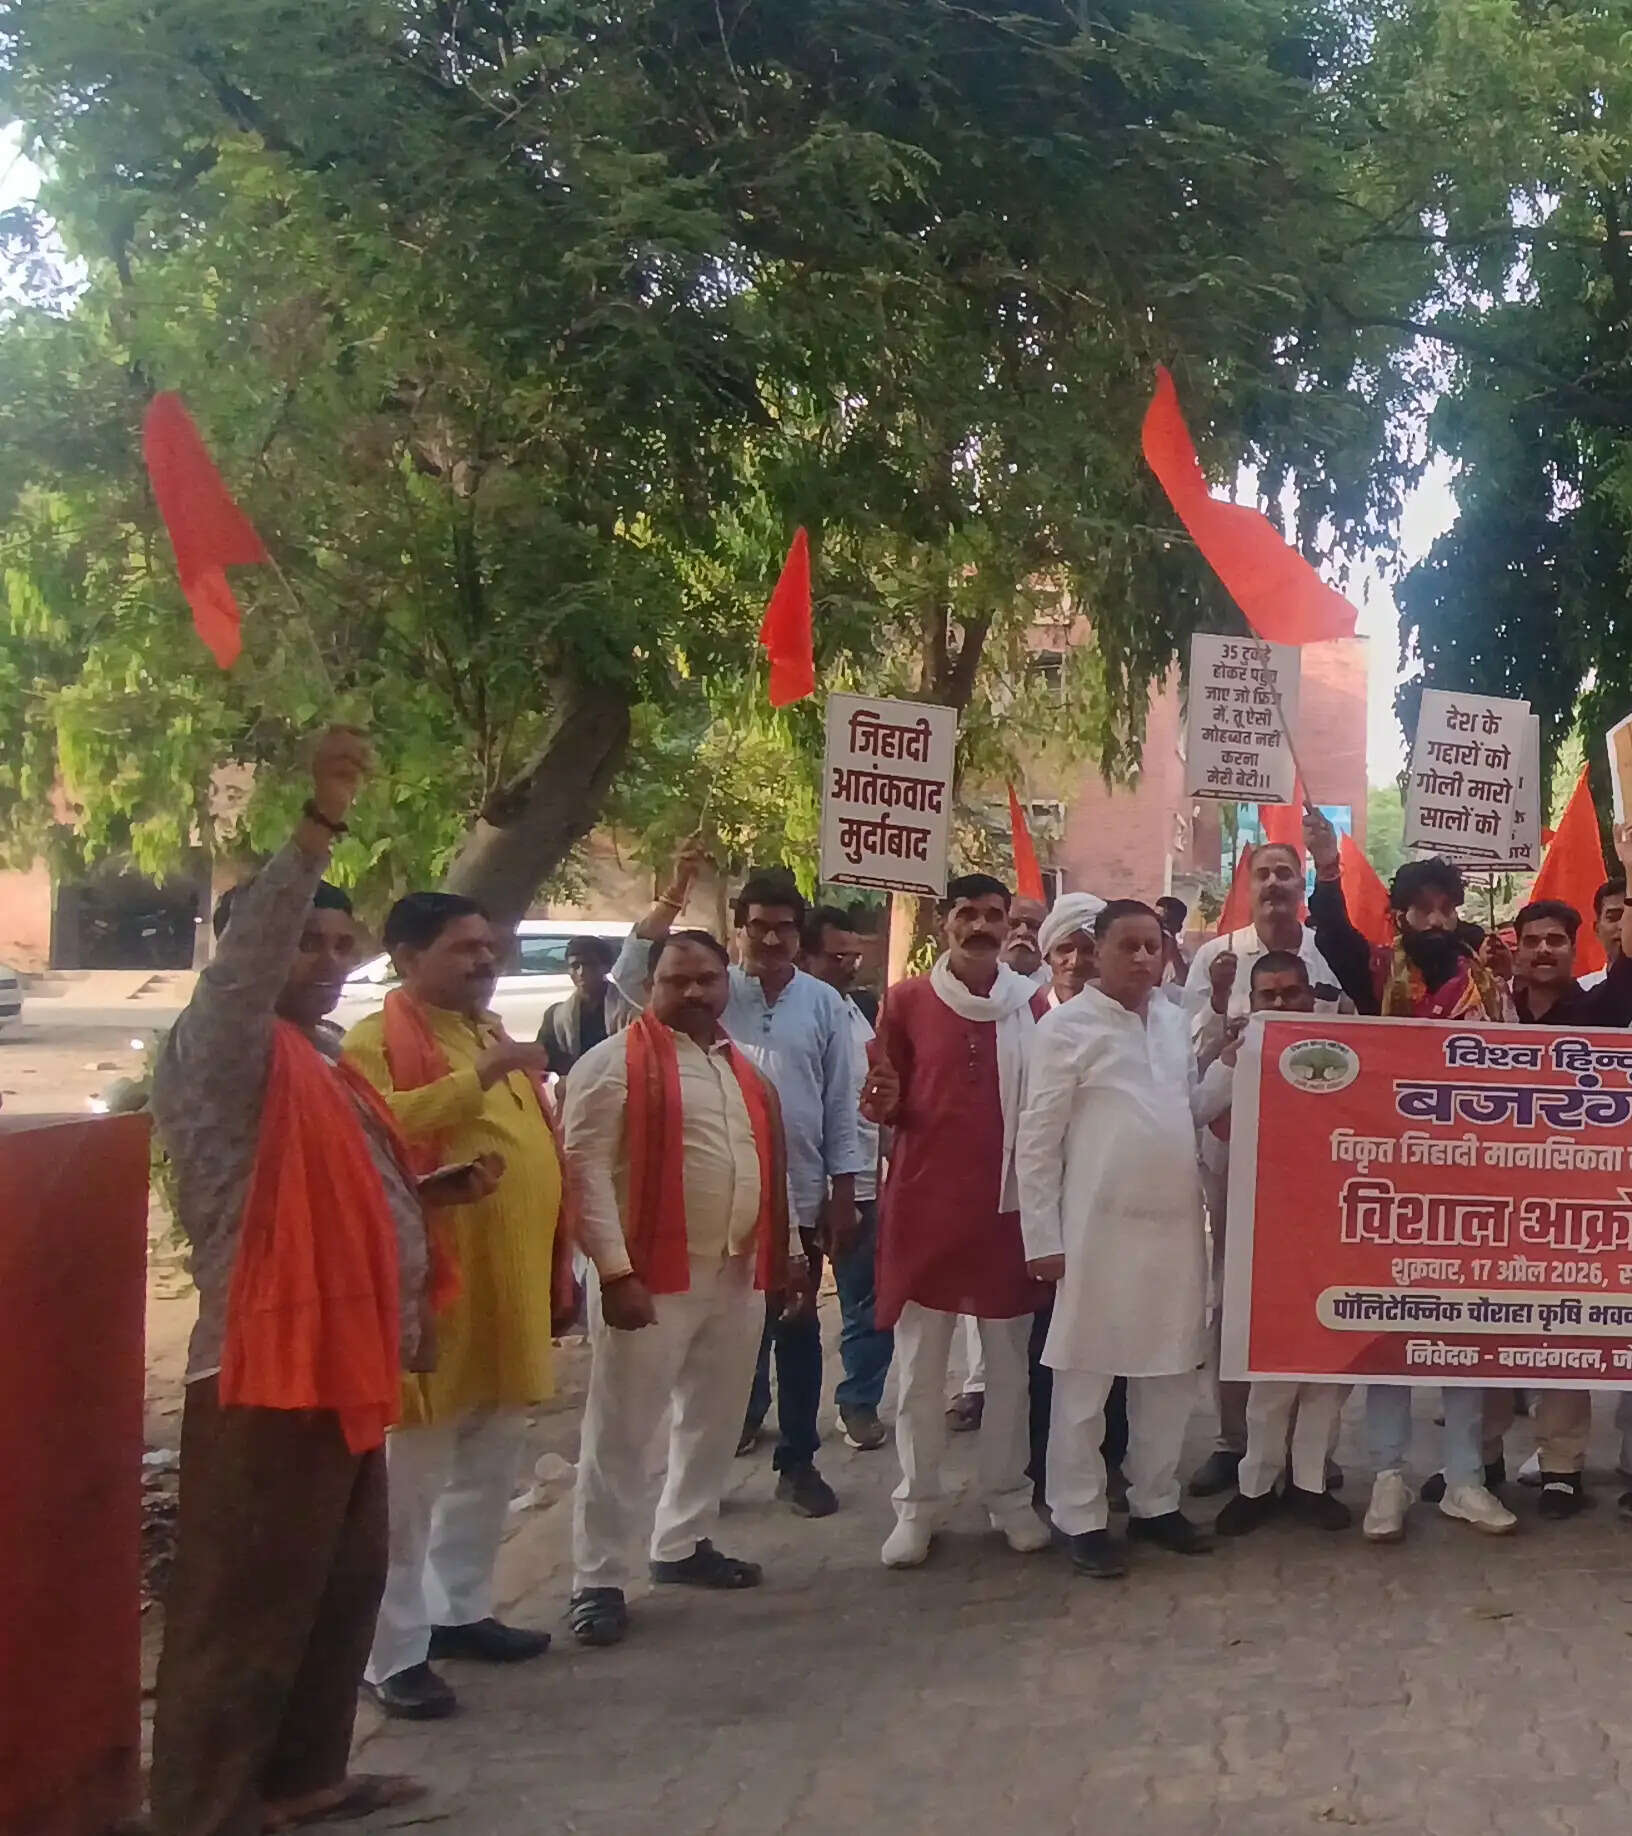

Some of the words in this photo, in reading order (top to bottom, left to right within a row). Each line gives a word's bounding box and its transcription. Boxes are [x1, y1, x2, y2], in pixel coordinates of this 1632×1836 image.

[1222, 644, 1238, 660] 35
[1213, 662, 1247, 681] होकर
[1205, 686, 1231, 701] जाए
[1233, 685, 1250, 704] जो
[1233, 709, 1245, 729] तू
[1246, 707, 1272, 726] ऐसी
[1446, 704, 1478, 732] देश
[1482, 709, 1502, 735] के
[849, 710, 932, 762] जिहादी
[1202, 725, 1252, 744] मोहब्बत
[1255, 729, 1283, 748] नहीं
[1221, 751, 1259, 766] करना
[1428, 740, 1484, 766] गद्दारों
[1485, 744, 1511, 770] को
[831, 764, 945, 813] आतंकवाद
[1207, 768, 1233, 785] मेरी
[1416, 768, 1464, 797] गोली
[1468, 777, 1513, 804] मारो
[1419, 806, 1474, 832] सालों
[1475, 810, 1501, 836] को
[839, 812, 931, 864] मुर्दाबाद
[1443, 1033, 1545, 1070] विश्व
[1330, 1128, 1397, 1174] विकृत
[1400, 1131, 1479, 1167] जिहादी
[1339, 1177, 1513, 1247] विशाल
[1392, 1257, 1465, 1285] शुक्रवार,
[1472, 1259, 1491, 1281] 17
[1551, 1261, 1608, 1288] 2026,
[1333, 1292, 1463, 1321] पॉलिटेक्निक
[1468, 1296, 1533, 1322] चौराहा
[1538, 1299, 1582, 1331] कृषि
[1406, 1339, 1480, 1367] निवेदक
[1498, 1342, 1606, 1372] बजरंगदल,
